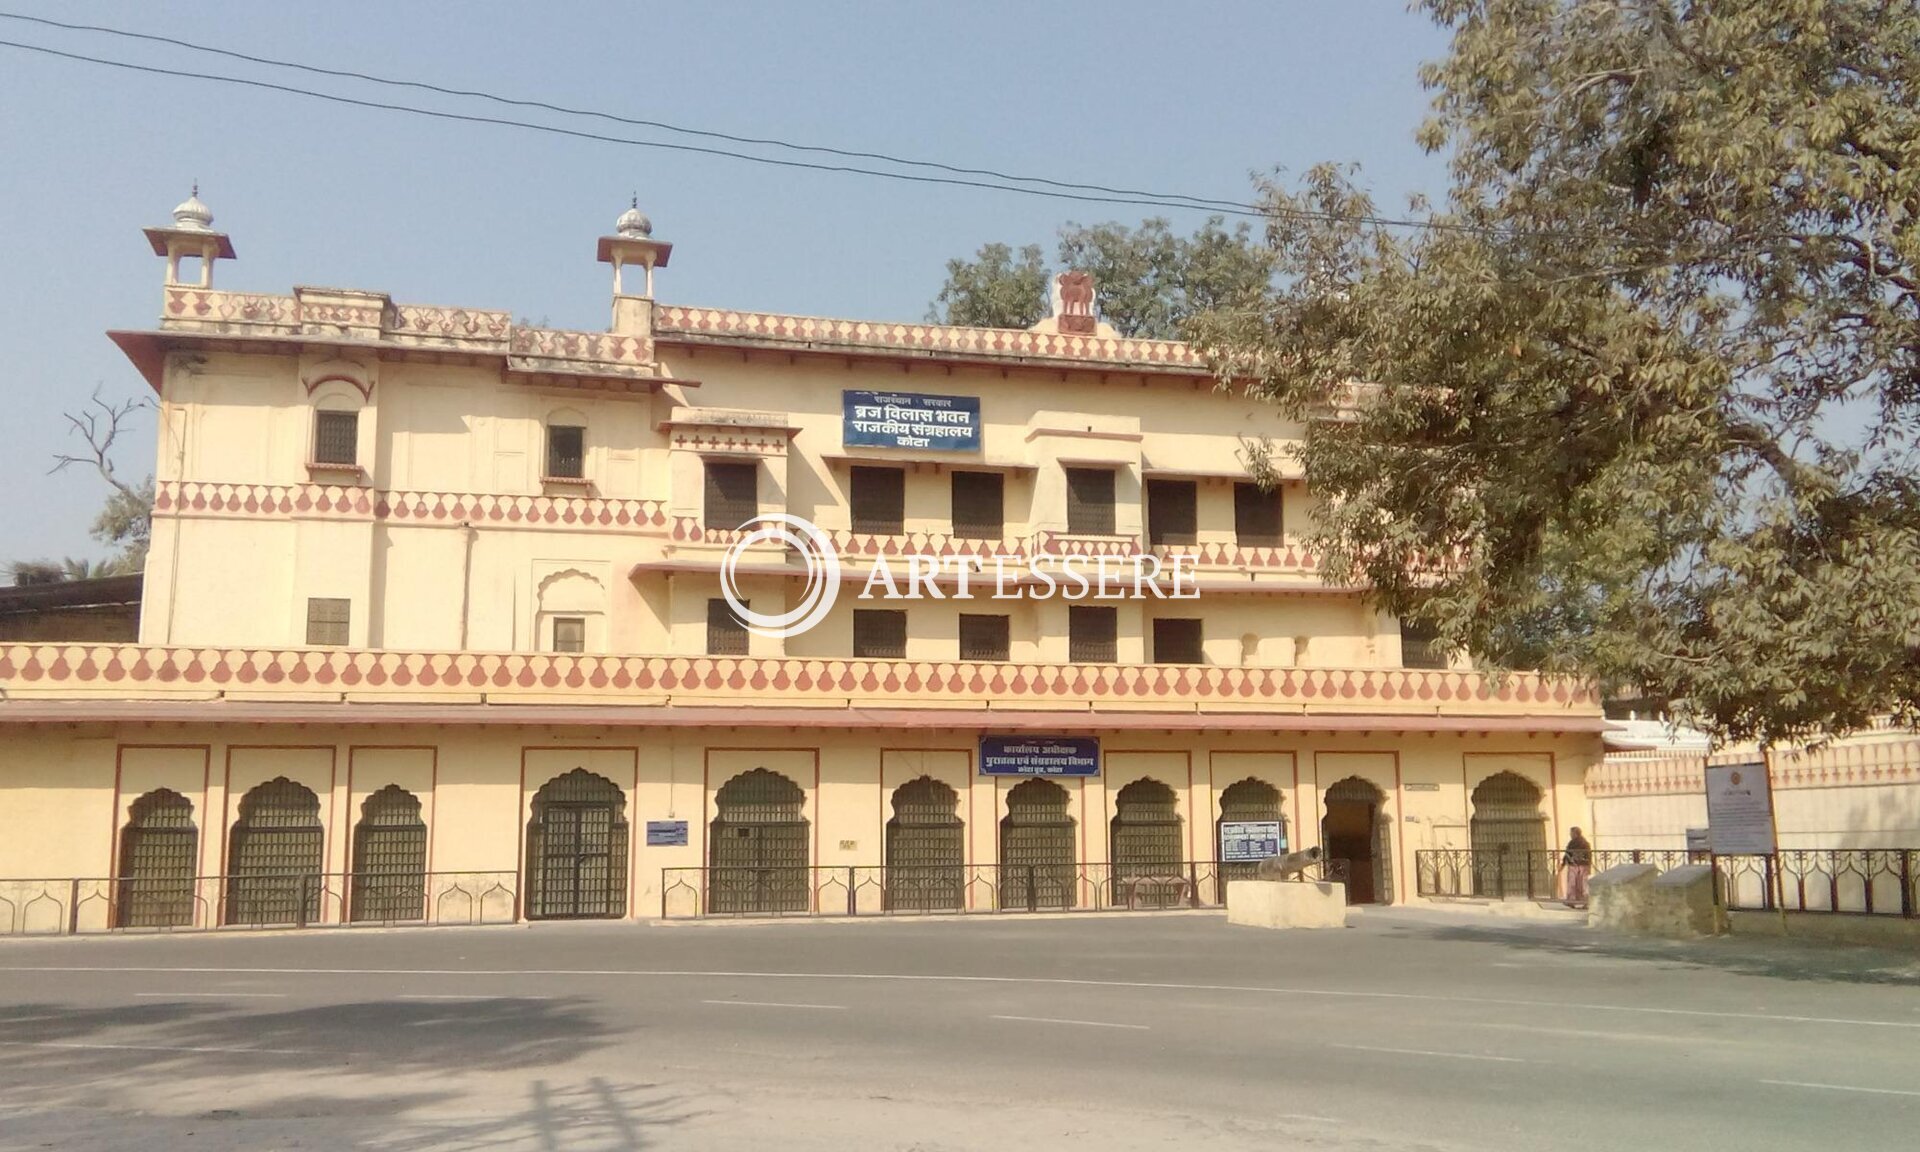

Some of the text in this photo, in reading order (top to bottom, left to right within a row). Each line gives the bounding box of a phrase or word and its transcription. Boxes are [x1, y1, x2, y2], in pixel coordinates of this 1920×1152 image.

[922, 398, 952, 408] सरकार
[854, 403, 970, 424] ब्रज विलास भवन
[852, 419, 973, 438] राजकीय संग्रहालय
[897, 435, 930, 447] कोटा
